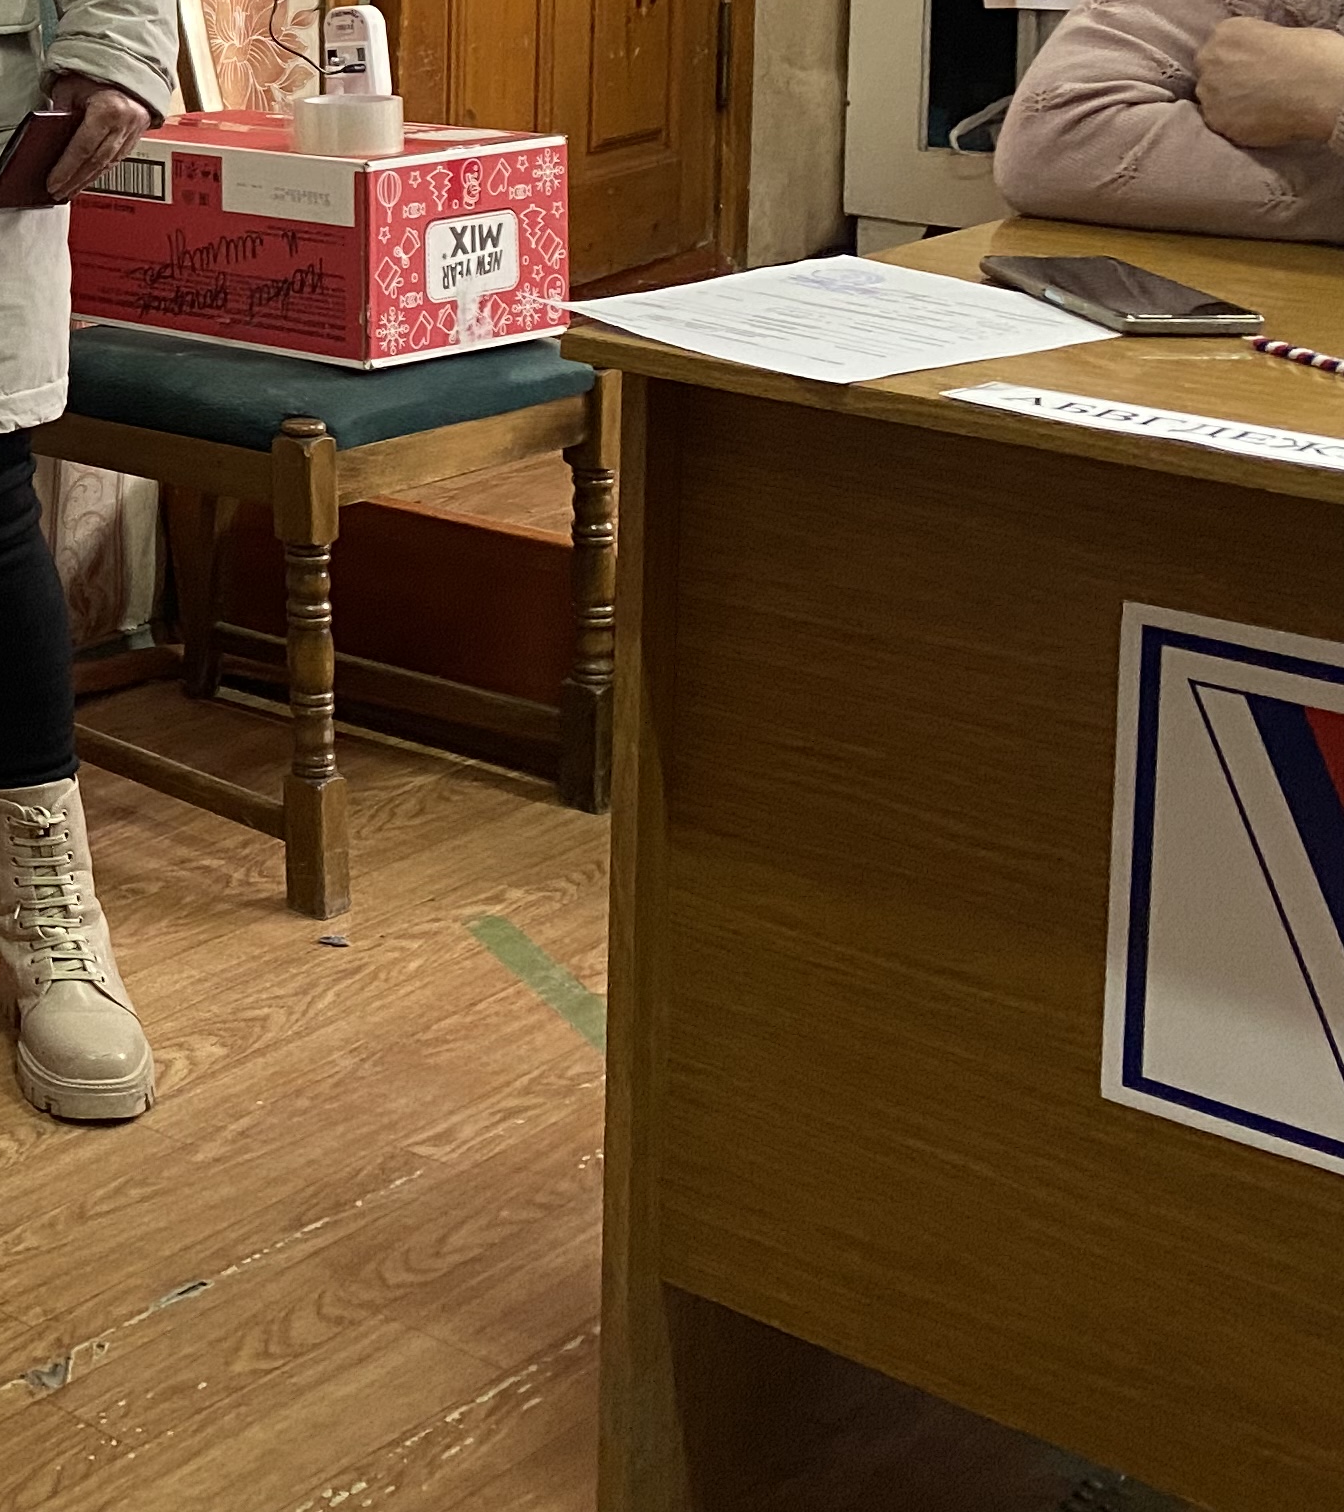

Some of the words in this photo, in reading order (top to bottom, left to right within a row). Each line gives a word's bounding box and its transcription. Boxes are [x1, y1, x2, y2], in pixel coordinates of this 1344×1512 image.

[448, 222, 503, 258] MIX
[442, 258, 471, 290] YEAR
[476, 249, 503, 278] NEW
